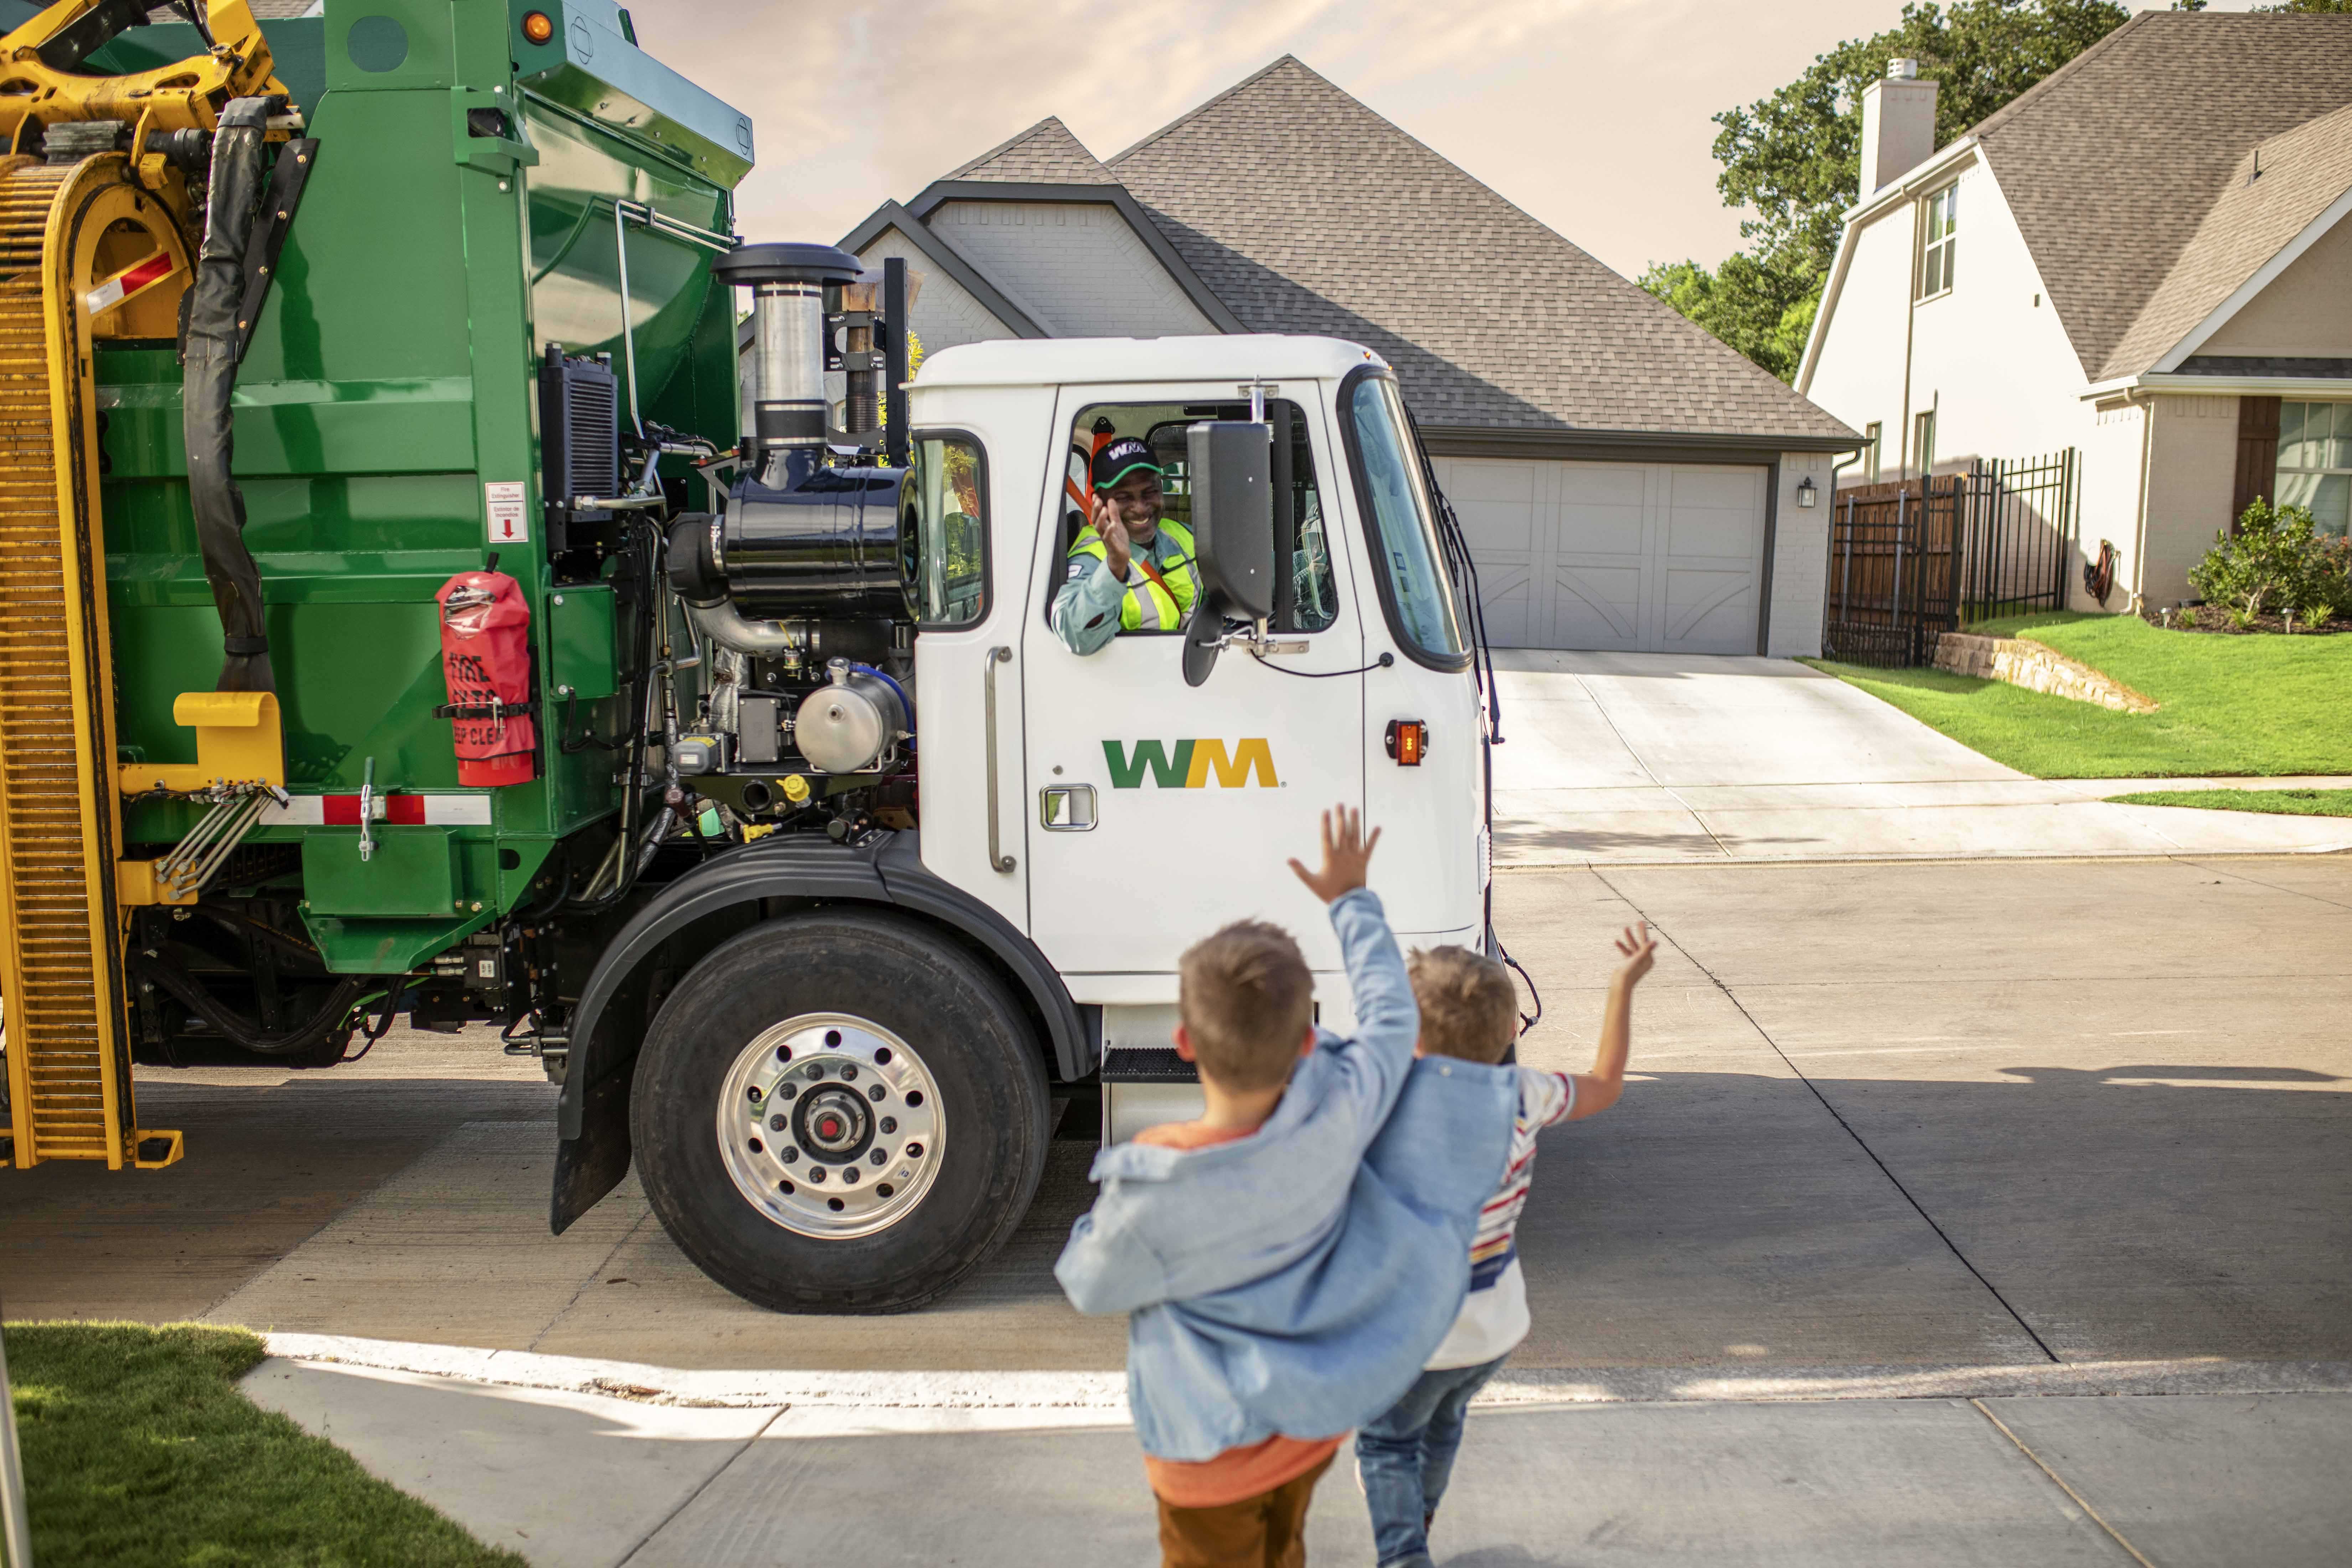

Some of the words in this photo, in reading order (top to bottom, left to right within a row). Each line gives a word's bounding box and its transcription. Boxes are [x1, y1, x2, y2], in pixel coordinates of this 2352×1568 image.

[1108, 442, 1147, 460] WM
[449, 652, 491, 682] FIRE
[470, 727, 504, 745] CLEA
[1102, 738, 1279, 789] WM
